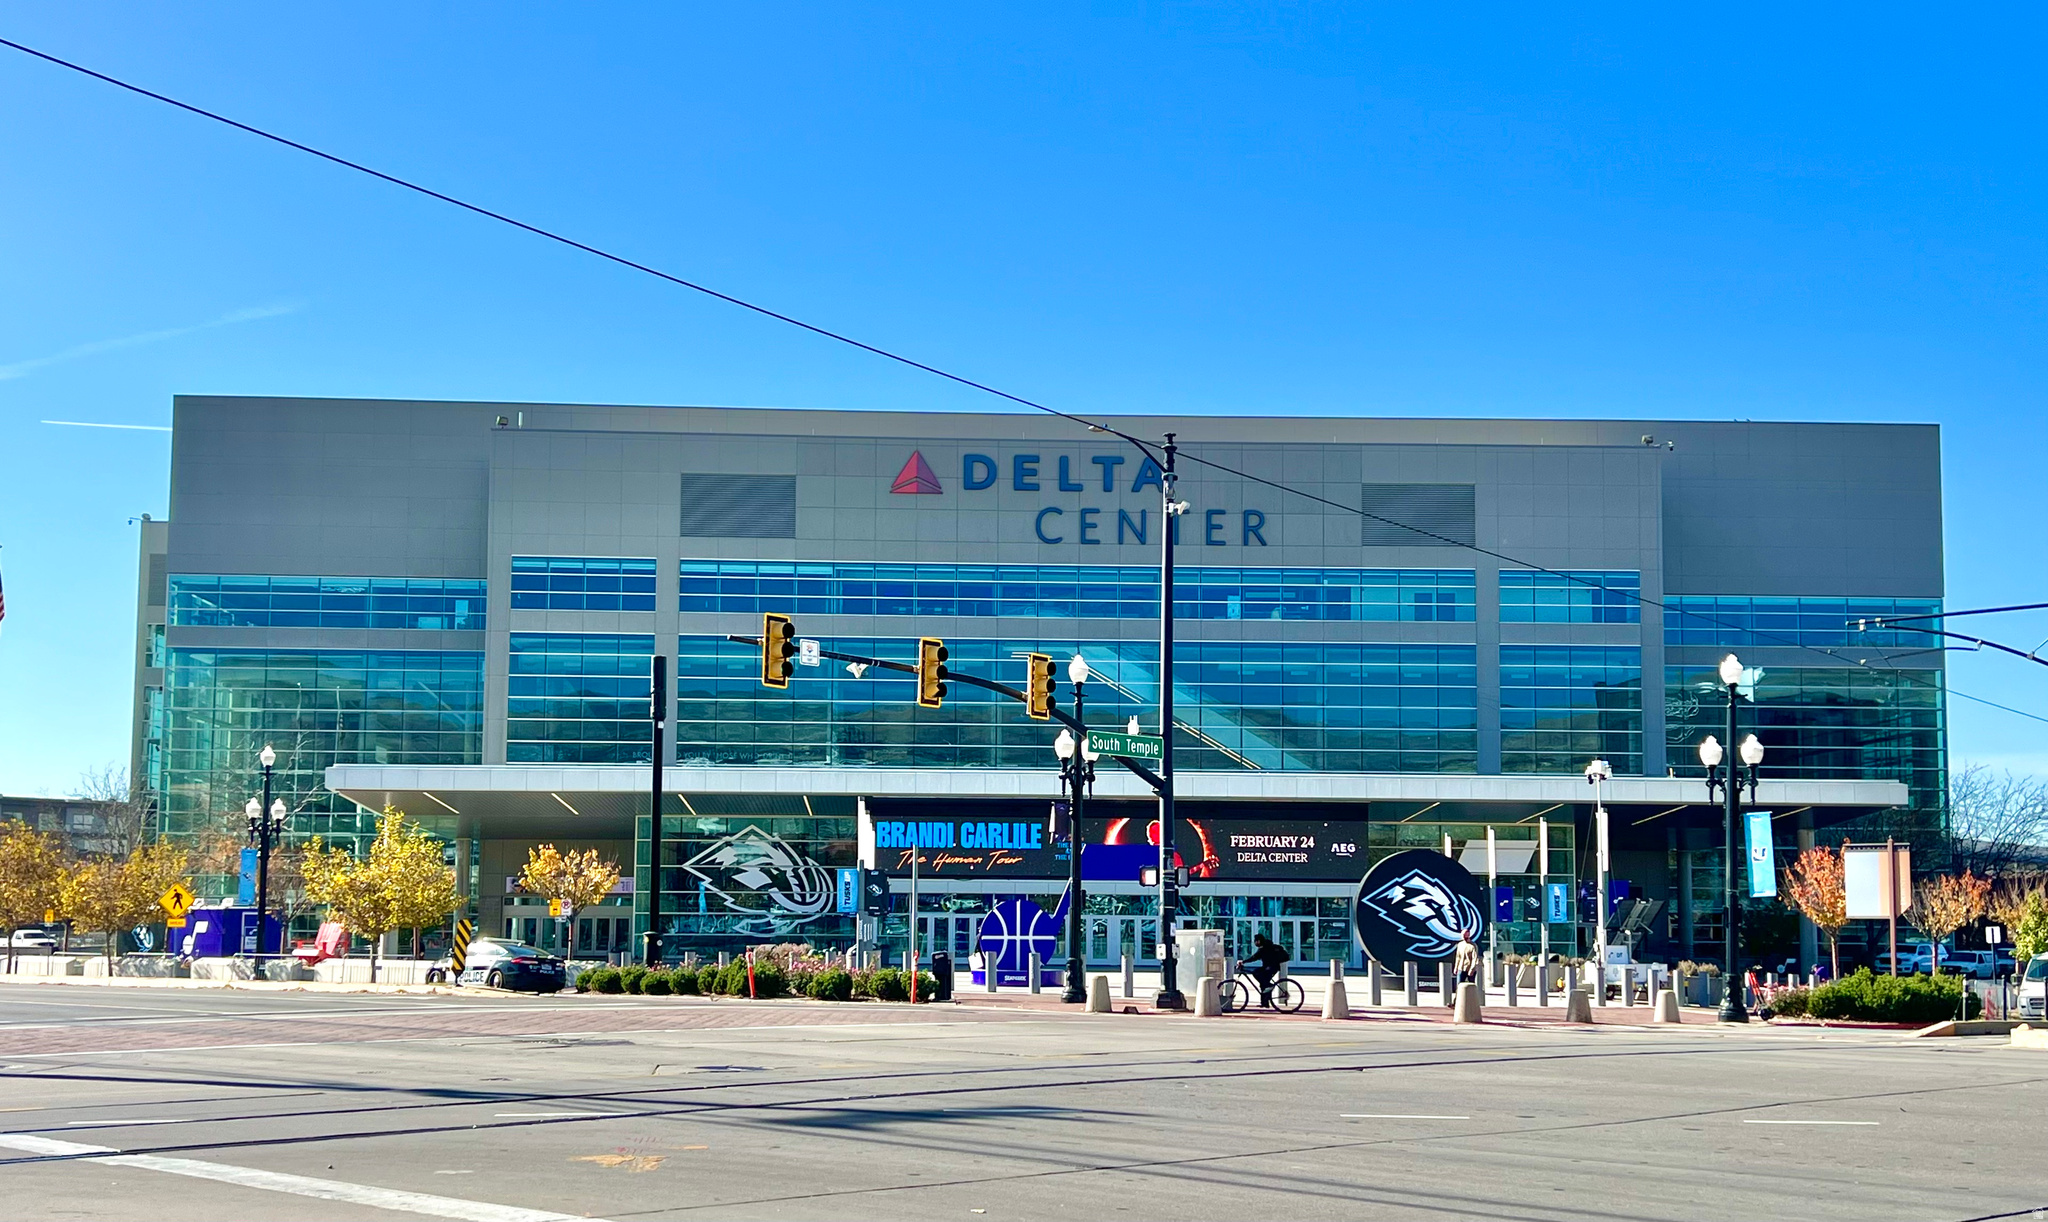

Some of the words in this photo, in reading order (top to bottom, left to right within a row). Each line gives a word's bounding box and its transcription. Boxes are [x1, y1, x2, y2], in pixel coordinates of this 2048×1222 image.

[963, 454, 1163, 493] DELTA
[1035, 507, 1267, 546] CENTER
[1092, 735, 1120, 752] South
[1126, 738, 1159, 757] Temple
[876, 821, 954, 848] BRANDI
[960, 822, 1042, 849] CARLILE
[1230, 835, 1299, 848] FEBRUARY
[1300, 836, 1315, 848] 24
[1331, 843, 1356, 853] AEG
[897, 850, 927, 870] The
[932, 852, 983, 872] Human
[986, 850, 1022, 871] Tour
[1237, 852, 1267, 862] DELTA
[1268, 852, 1309, 863] CENTER
[844, 871, 851, 882] UP
[459, 971, 484, 983] POLICE
